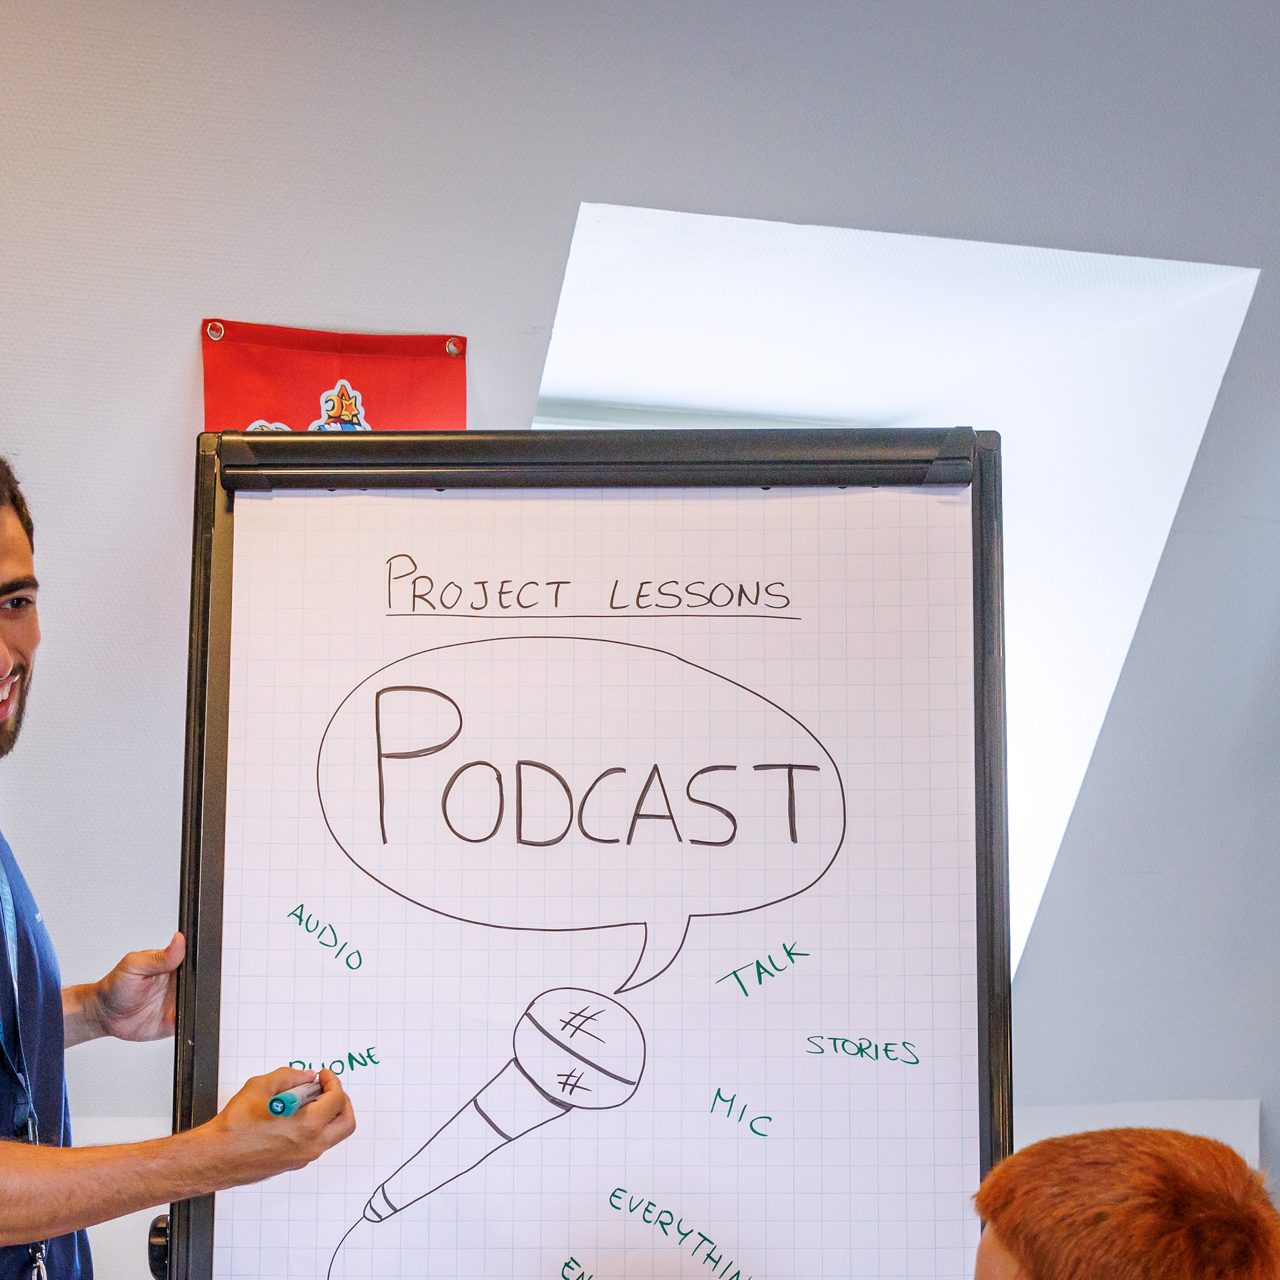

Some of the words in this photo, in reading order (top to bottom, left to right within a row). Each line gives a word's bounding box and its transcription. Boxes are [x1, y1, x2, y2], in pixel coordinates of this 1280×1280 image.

[386, 554, 572, 611] PROJECT
[609, 579, 792, 611] LESSONS
[375, 685, 820, 846] PODCAST
[286, 902, 363, 972] AUDIO
[715, 940, 811, 999] TALK
[805, 1035, 920, 1066] STORIES
[709, 1087, 773, 1138] MIC
